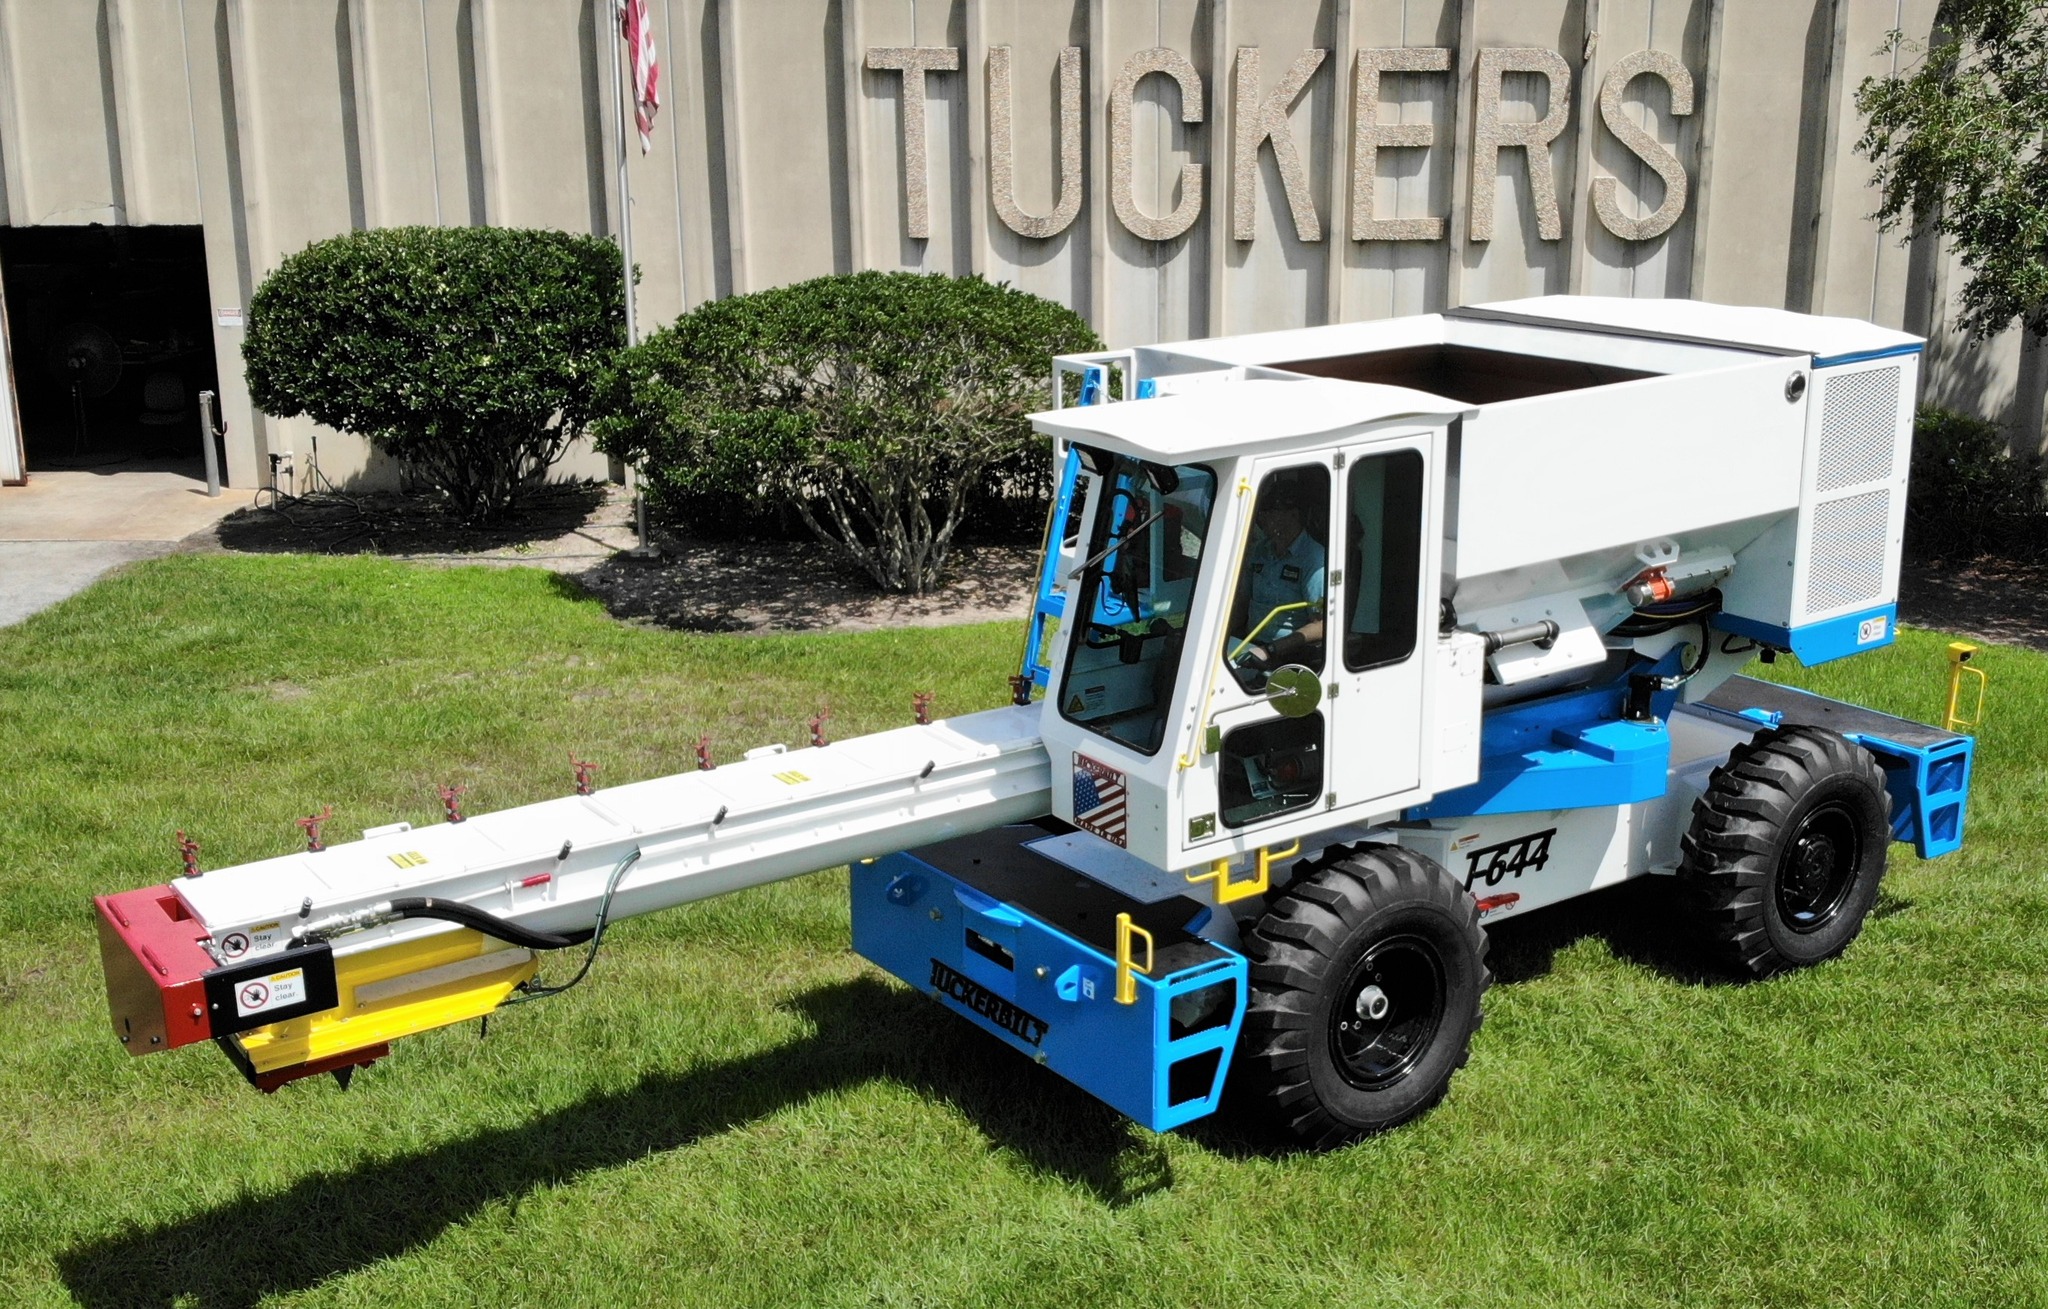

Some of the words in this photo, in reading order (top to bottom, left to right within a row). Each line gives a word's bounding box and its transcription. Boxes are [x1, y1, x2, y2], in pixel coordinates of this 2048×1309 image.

[866, 31, 1694, 241] TUCKER'S
[254, 934, 272, 942] Stay
[274, 983, 293, 991] Stay
[930, 957, 1049, 1048] TUCKERBILT
